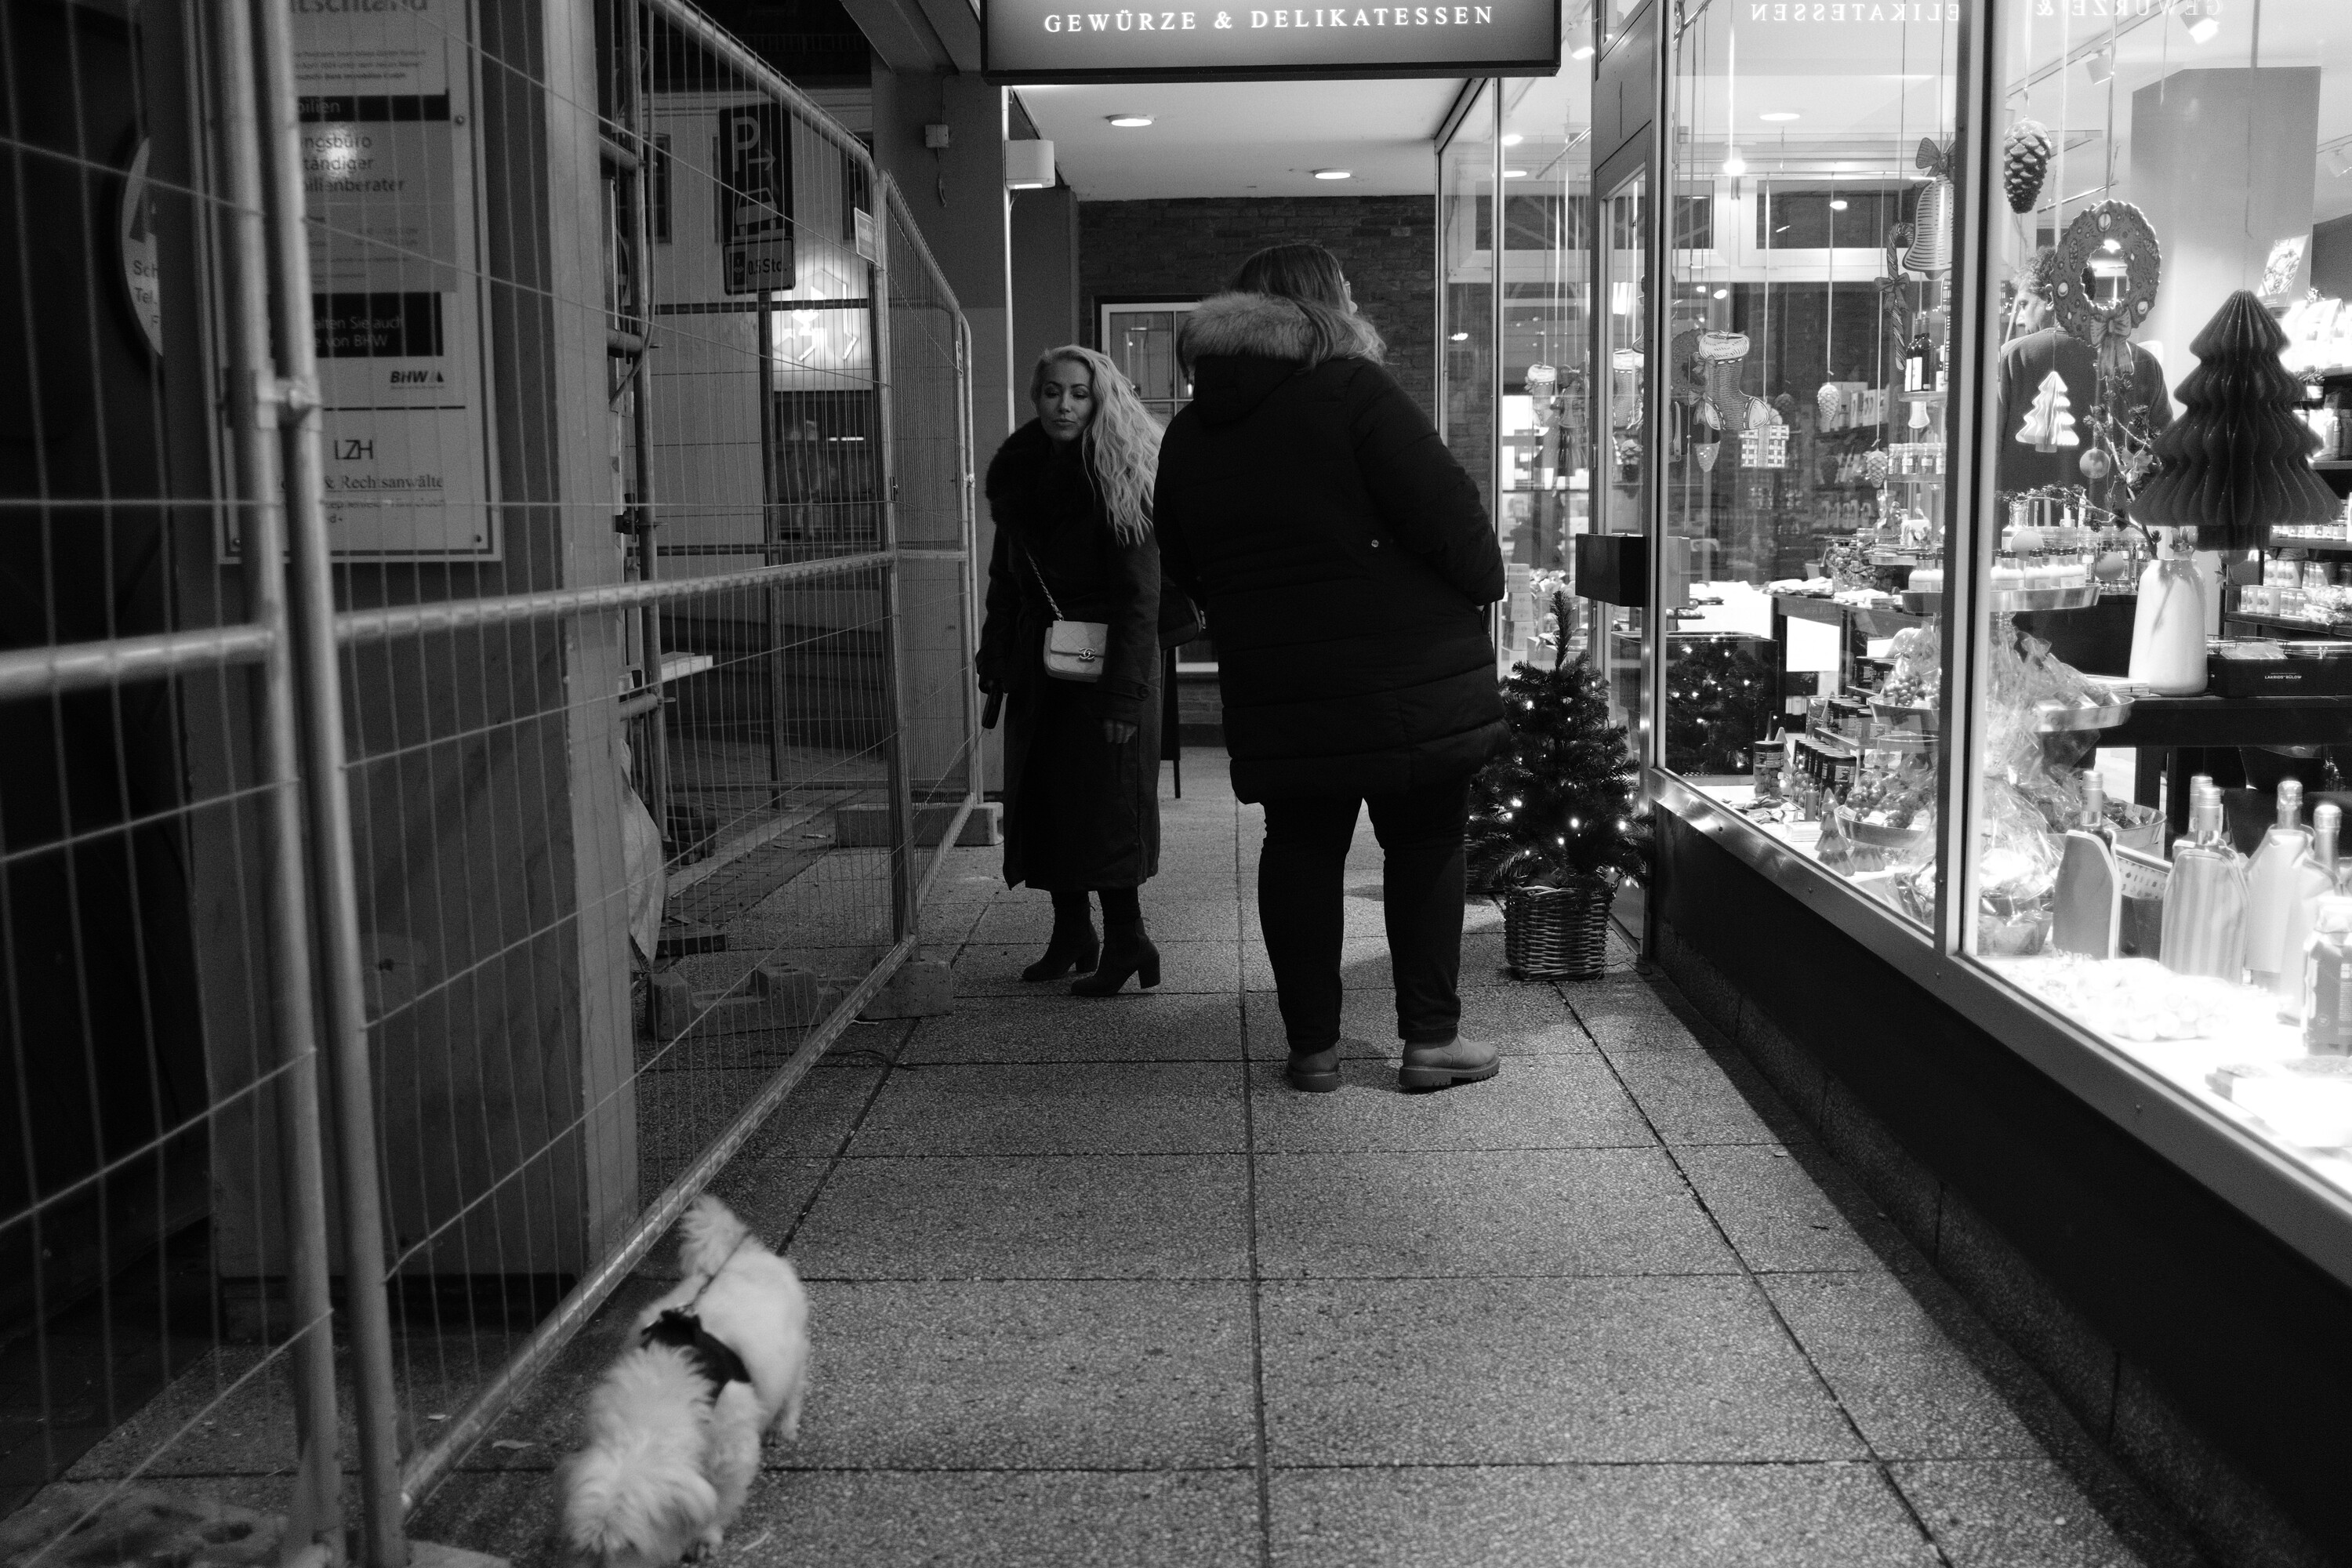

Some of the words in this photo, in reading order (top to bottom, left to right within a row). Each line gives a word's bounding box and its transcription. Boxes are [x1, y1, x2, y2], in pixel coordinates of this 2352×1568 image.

[291, 0, 429, 13] tschland
[1044, 9, 1196, 32] GEWÜRZE
[1214, 11, 1232, 29] &
[1250, 6, 1492, 28] DELIKATESSEN
[303, 134, 372, 152] ngsbüro
[732, 116, 760, 172] P
[303, 155, 375, 174] tändiger
[763, 256, 788, 274] Std.
[350, 315, 371, 329] Sie
[390, 371, 428, 383] BHW
[334, 440, 374, 460] LZH
